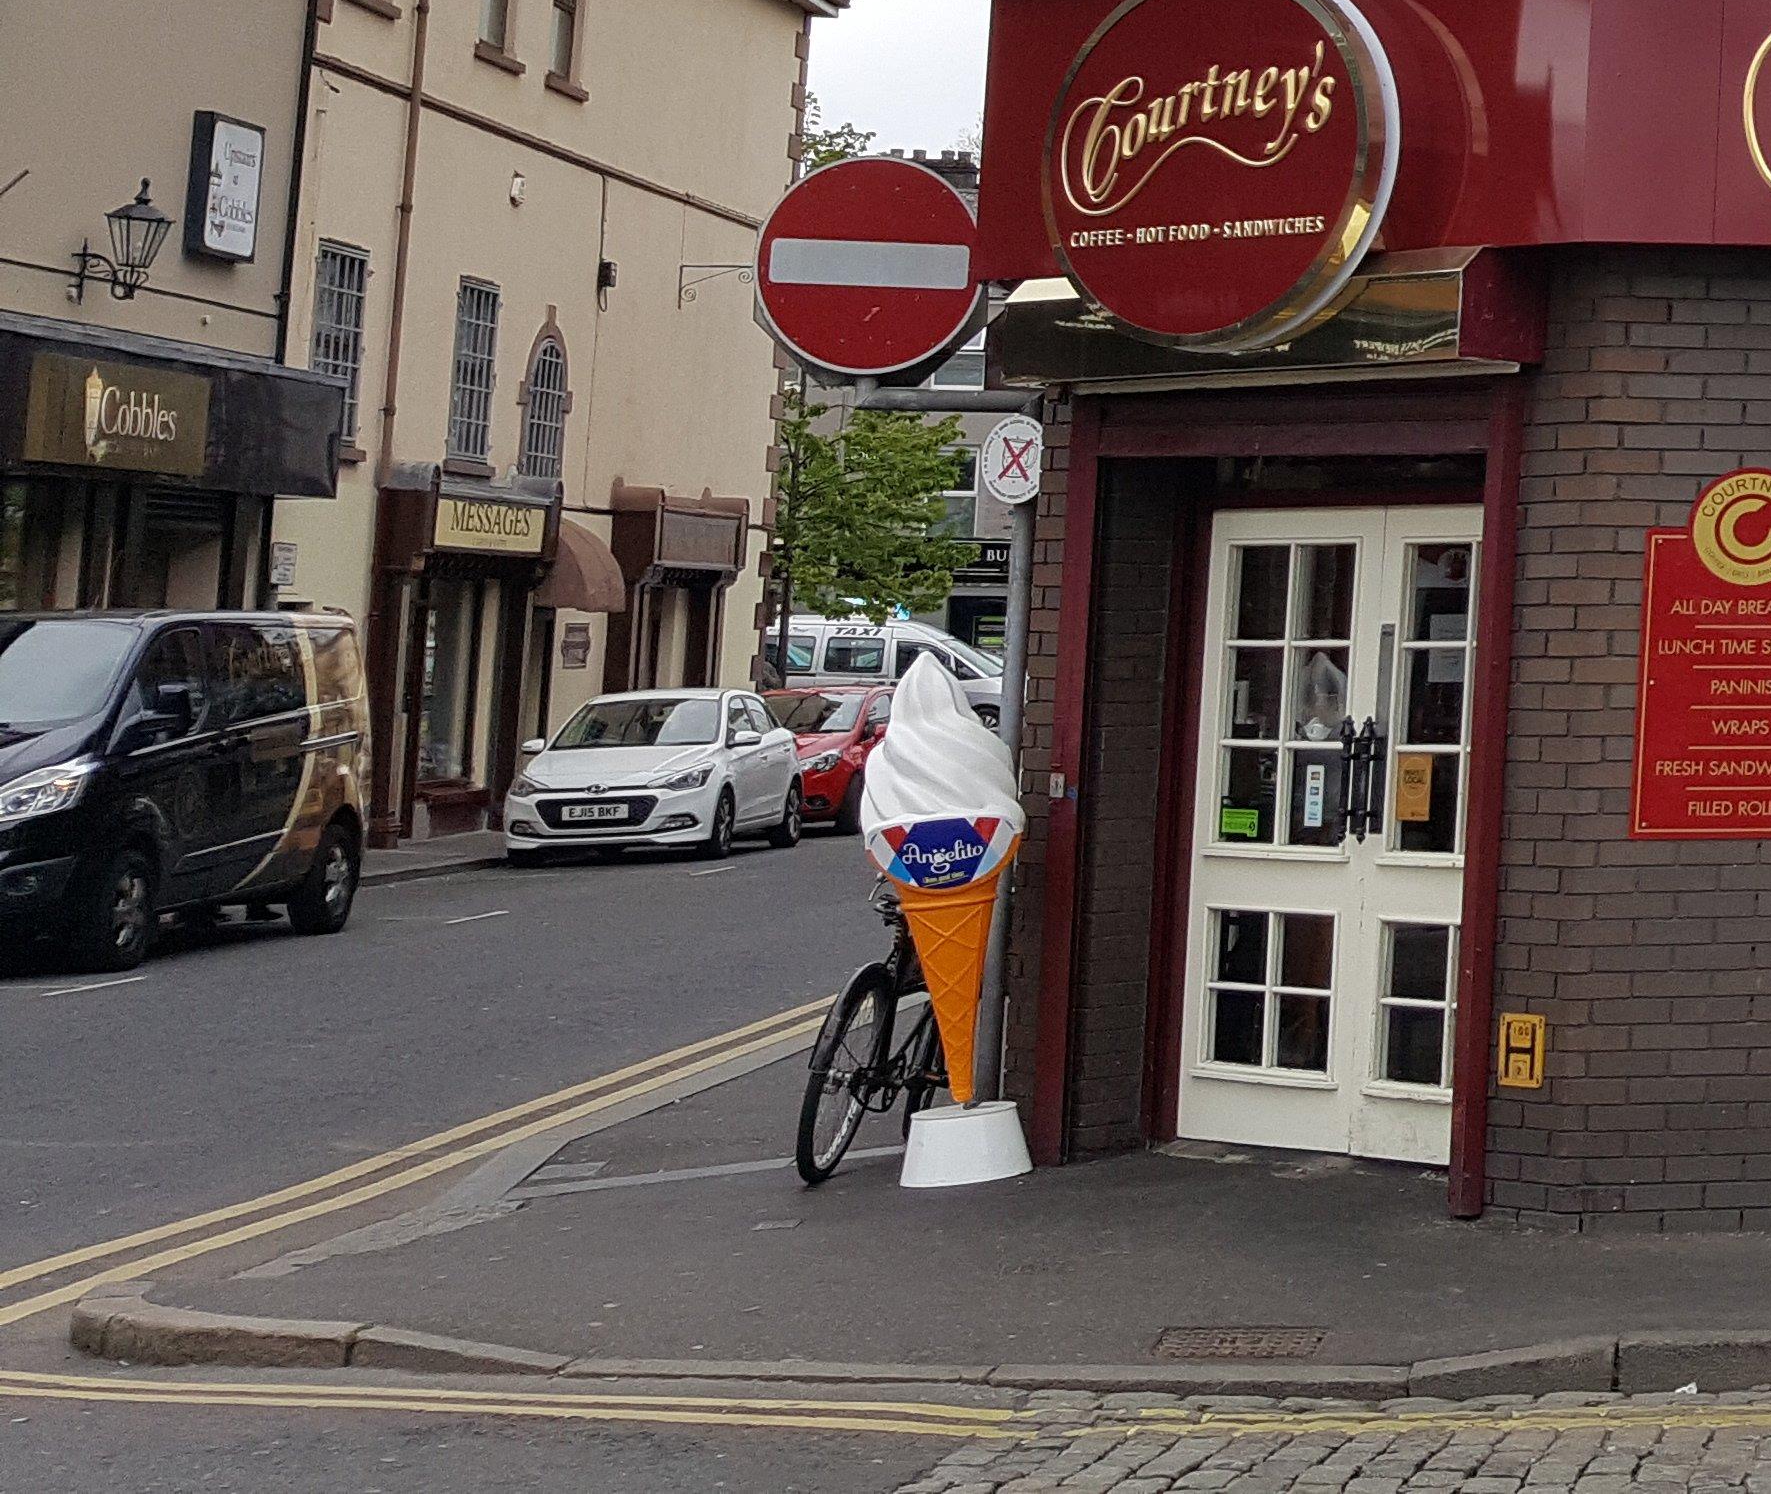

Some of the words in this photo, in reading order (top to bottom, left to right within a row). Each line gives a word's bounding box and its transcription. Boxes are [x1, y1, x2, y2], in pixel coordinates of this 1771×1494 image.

[1061, 39, 1336, 212] Courtney's
[1070, 228, 1124, 248] COFFEE
[1136, 226, 1167, 244] HOT
[1168, 223, 1211, 242] FOOD
[1222, 215, 1326, 239] SANDWICHES
[101, 386, 178, 442] Cobbles
[450, 501, 531, 537] MESSAGES
[986, 549, 1008, 562] BU
[1671, 599, 1697, 615] ALL
[1701, 599, 1733, 615] DAY
[834, 626, 884, 637] TAXI
[1658, 639, 1715, 655] LUNCH
[1720, 639, 1756, 655] TIME
[1712, 719, 1770, 735] WRAPS
[1655, 760, 1703, 776] FRESH
[1688, 801, 1733, 817] FILLED
[902, 840, 984, 874] Angelito
